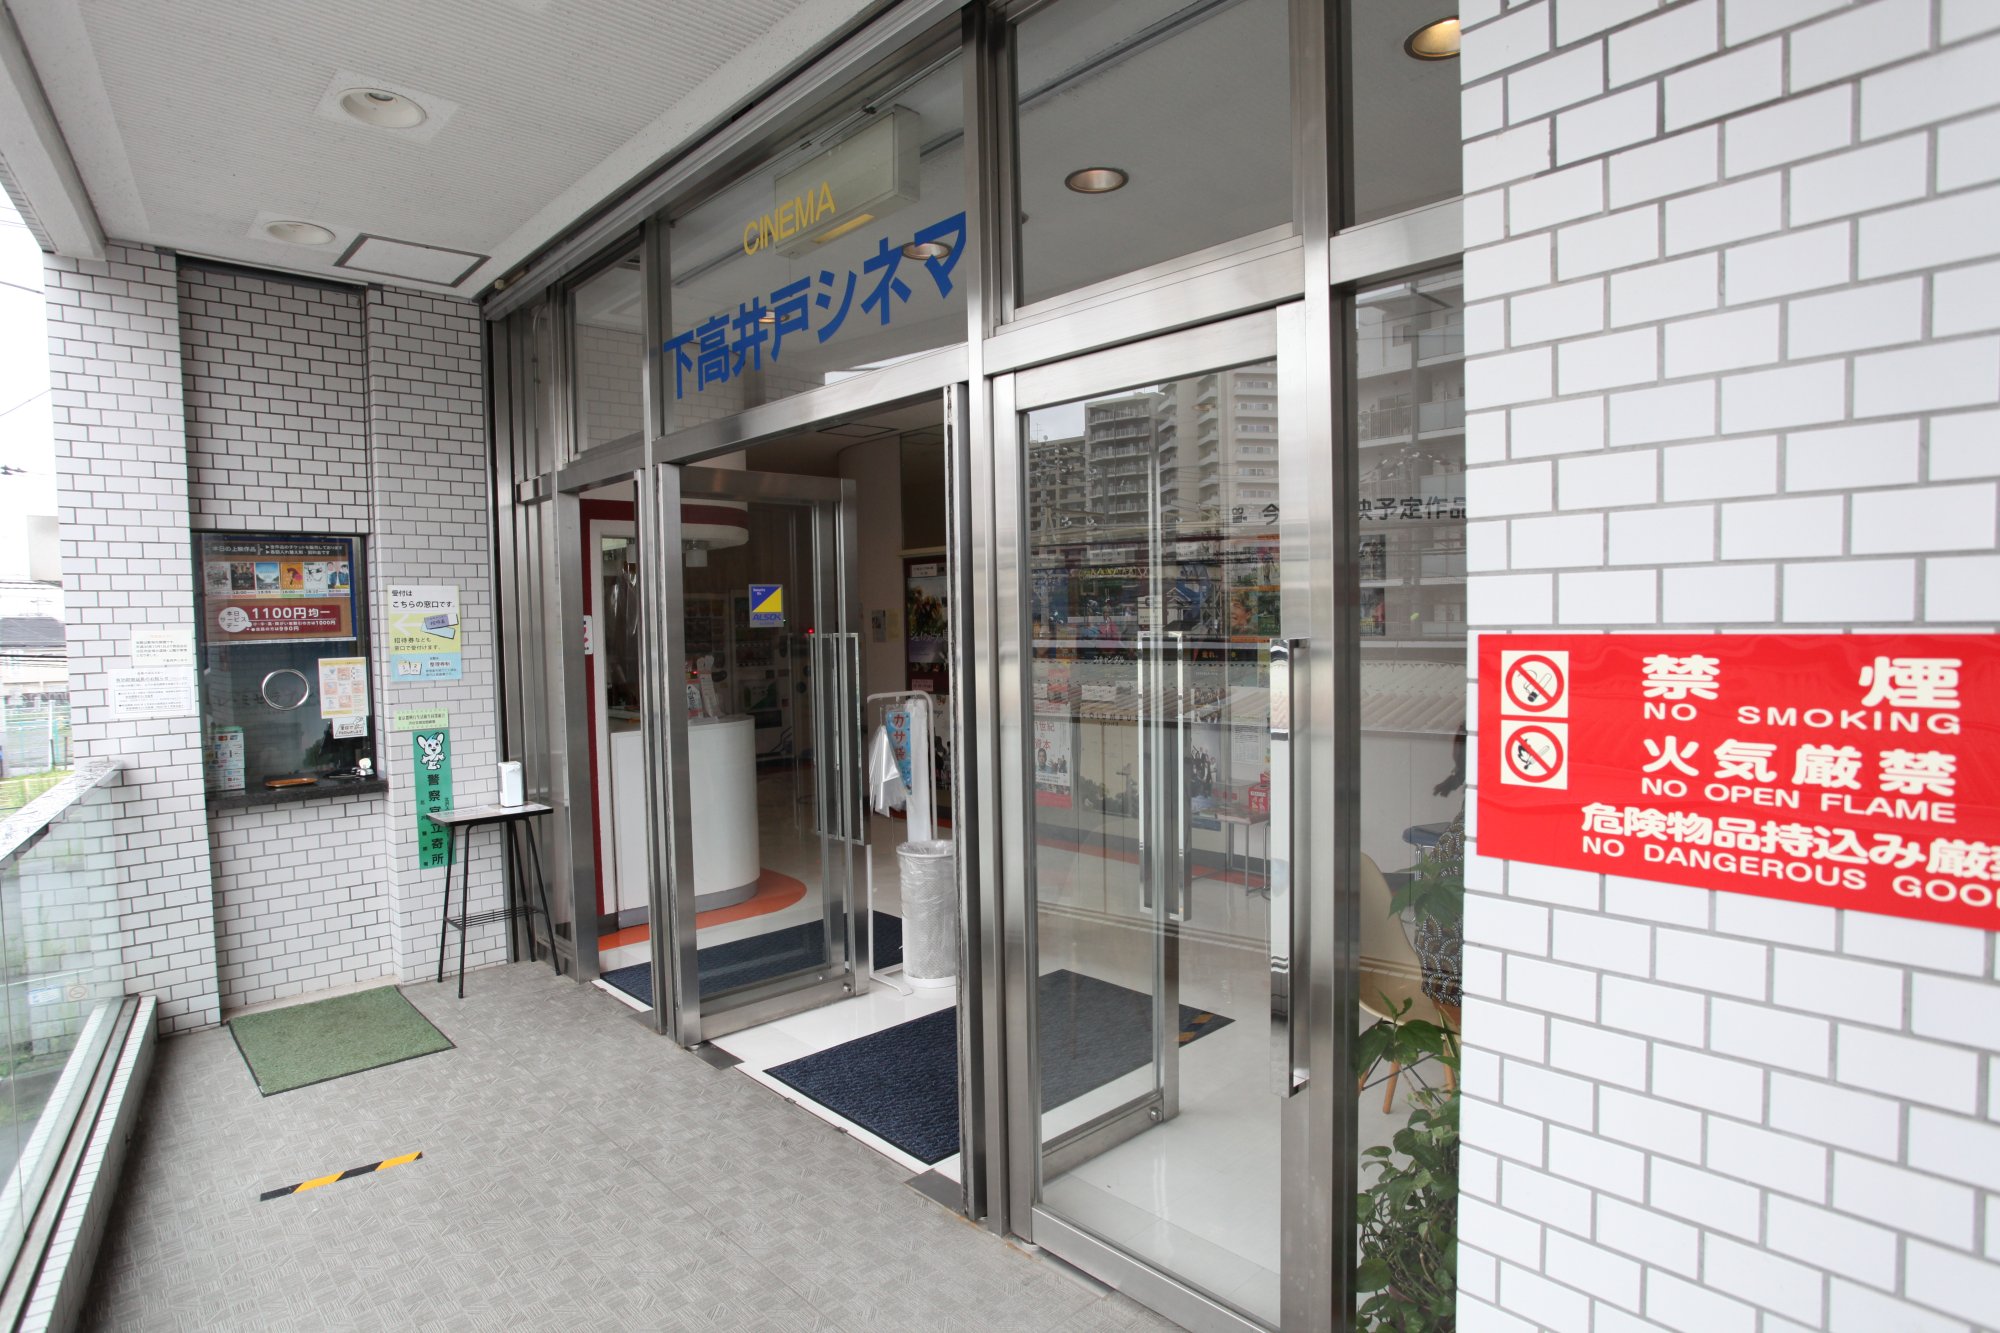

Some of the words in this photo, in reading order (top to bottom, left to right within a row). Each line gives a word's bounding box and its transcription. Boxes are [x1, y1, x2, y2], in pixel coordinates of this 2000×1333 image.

[744, 181, 836, 256] CINEMA
[663, 211, 966, 400] 下高井戸シネマ
[252, 607, 331, 619] 1100円均一
[391, 589, 412, 597] 受付は
[392, 600, 456, 609] こちらの窓口です。
[1643, 702, 1698, 722] NO
[1737, 705, 1961, 735] SMOKING
[1641, 735, 1957, 798] 火気厳禁
[1640, 777, 1688, 799] NO
[1703, 782, 1800, 809] OPEN
[1820, 792, 1957, 824] FLAME
[1581, 801, 2000, 881] 危険物品持込み厳
[1582, 835, 1625, 858] NO
[1644, 843, 1867, 890] DANGEROUS
[1892, 875, 2000, 910] GOO
